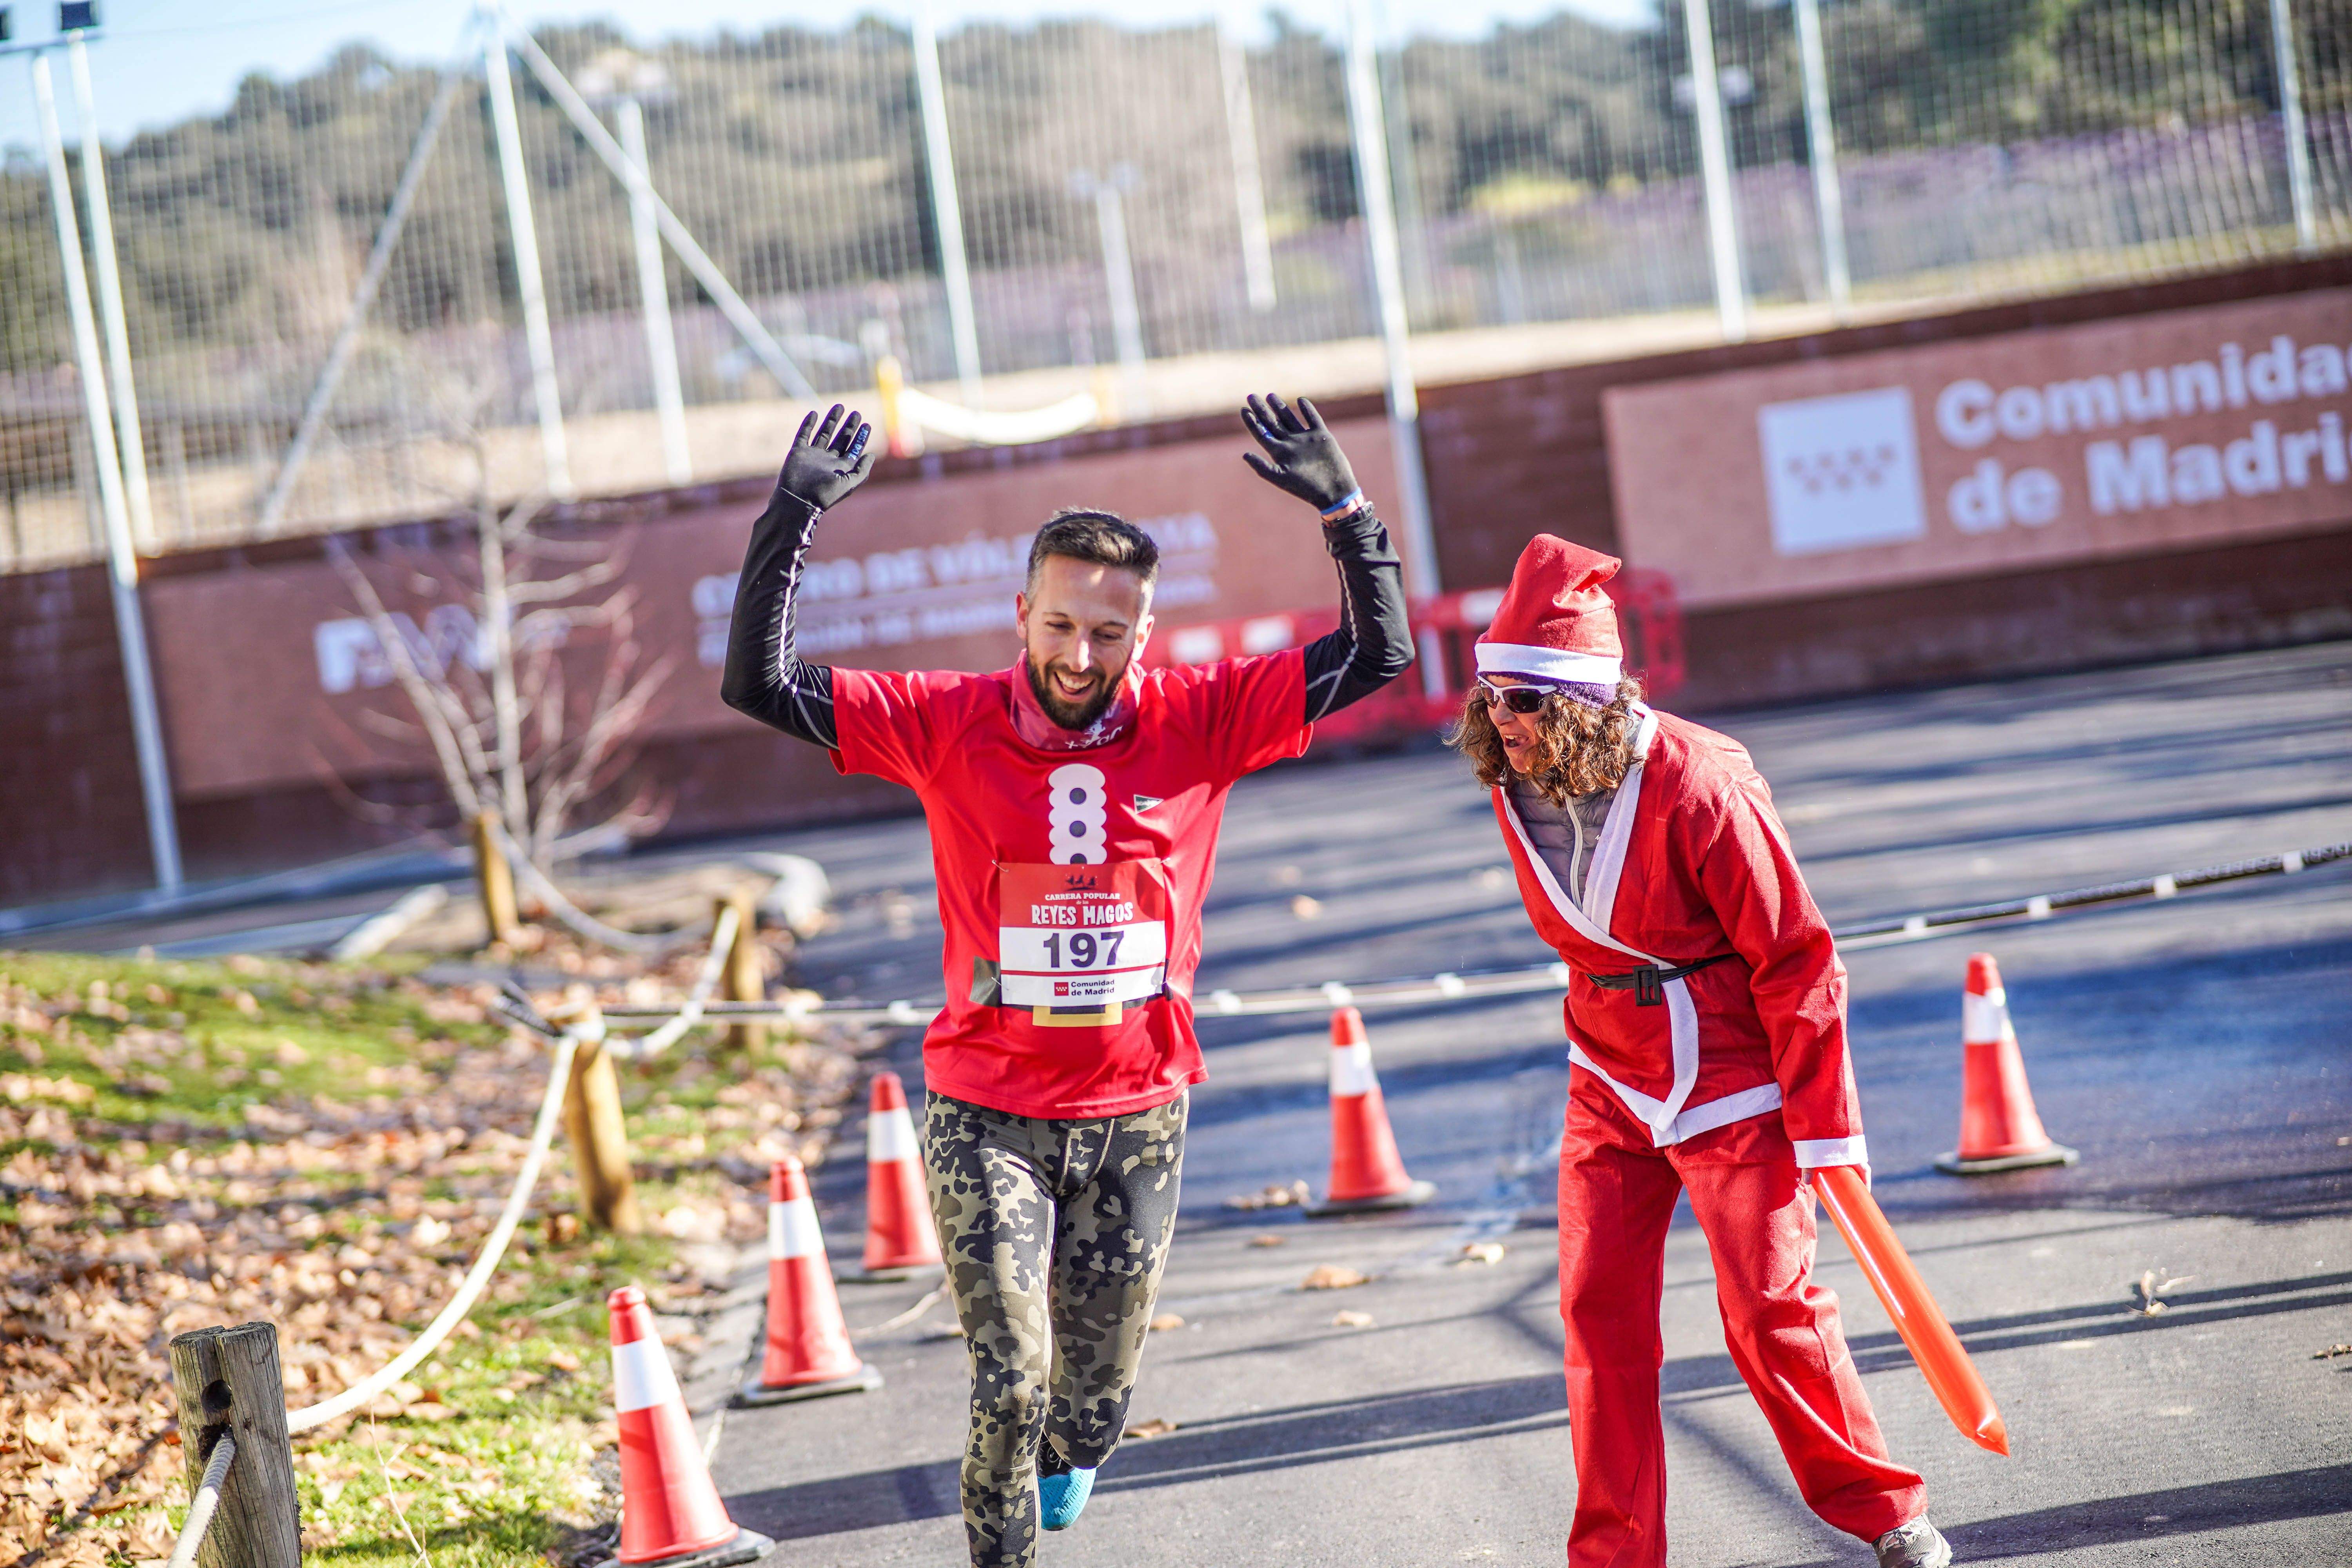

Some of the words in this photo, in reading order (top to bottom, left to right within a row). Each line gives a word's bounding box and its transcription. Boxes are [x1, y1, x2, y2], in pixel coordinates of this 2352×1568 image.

[1935, 334, 2352, 448] Comunida
[1947, 458, 2063, 534] de
[2085, 411, 2352, 515] Madri
[1031, 904, 1077, 926] REYES
[1083, 901, 1134, 926] MAGOS
[1044, 931, 1124, 968] 197
[1071, 979, 1115, 987] Comunidad
